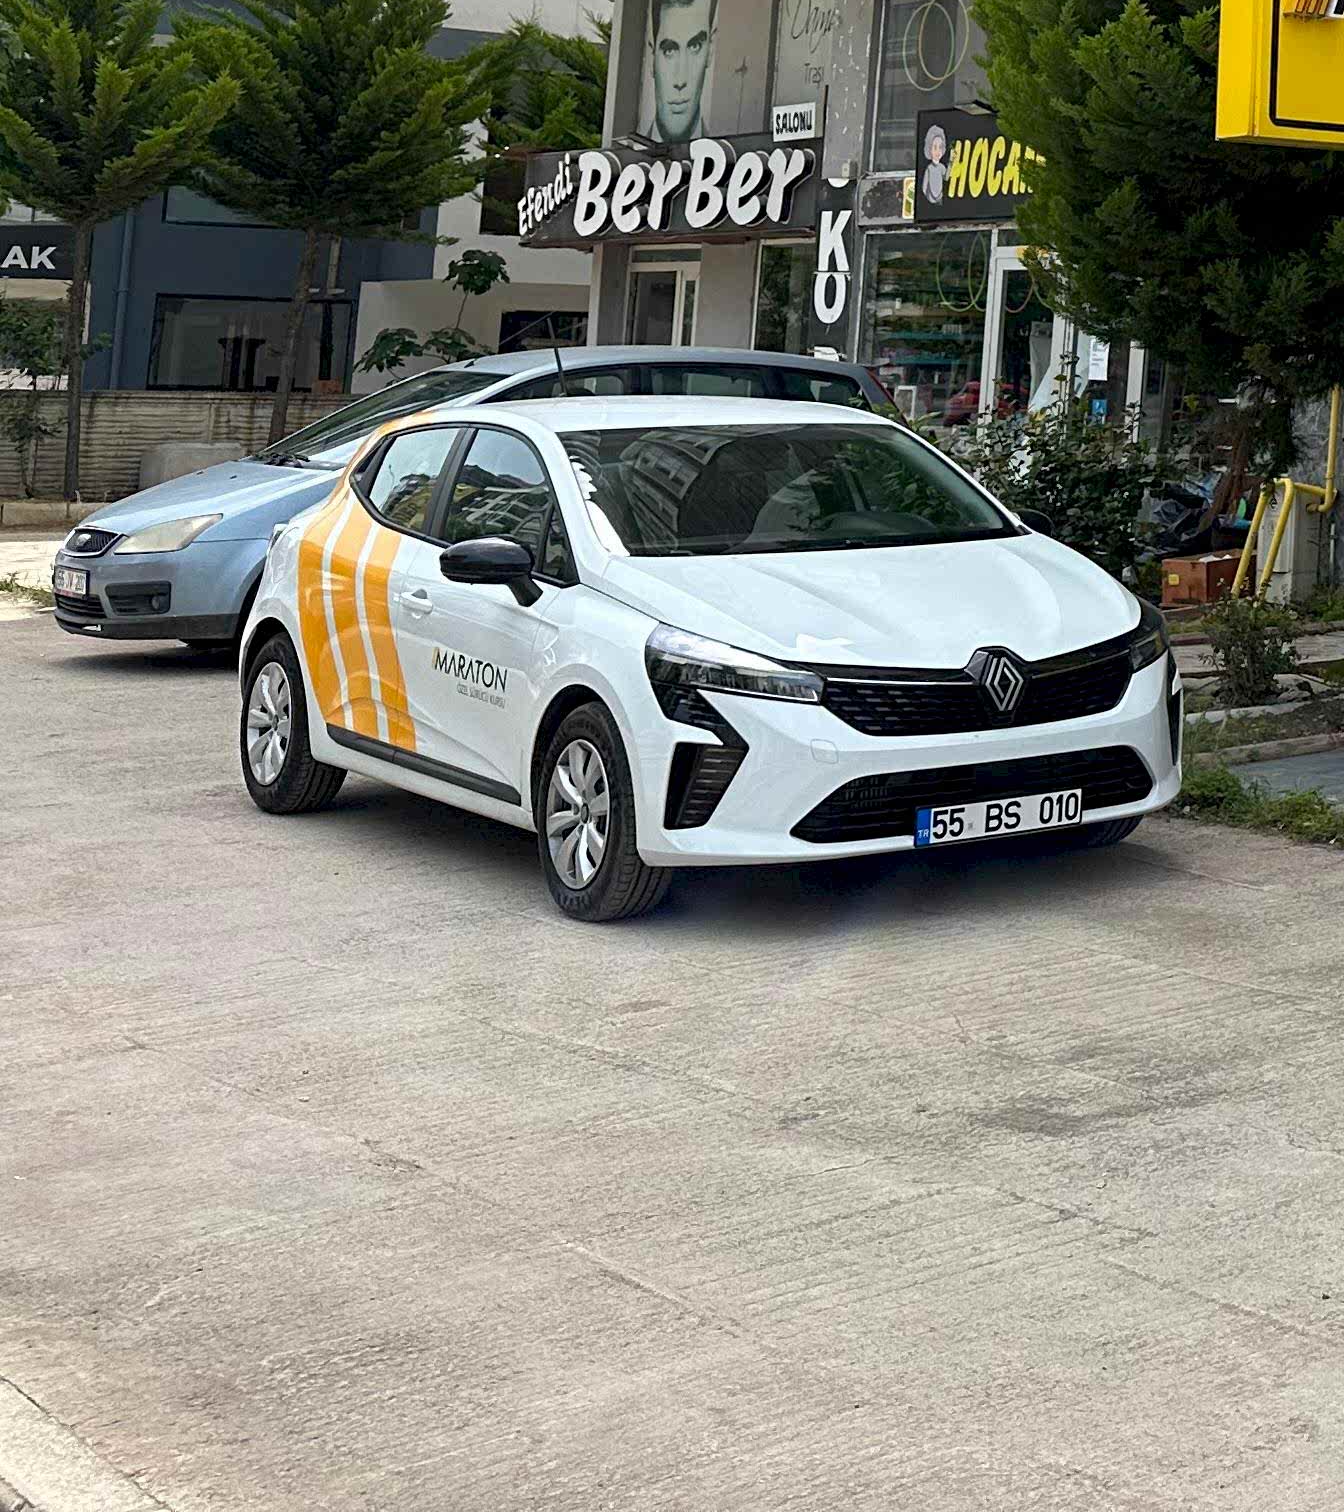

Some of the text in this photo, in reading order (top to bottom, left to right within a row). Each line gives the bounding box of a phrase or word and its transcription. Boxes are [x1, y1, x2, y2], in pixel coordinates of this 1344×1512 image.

[775, 110, 812, 134] SALONU
[517, 153, 574, 237] Efendi
[435, 648, 508, 693] MARATON
[918, 829, 930, 839] TR
[932, 792, 1080, 840] 55 BS 010
